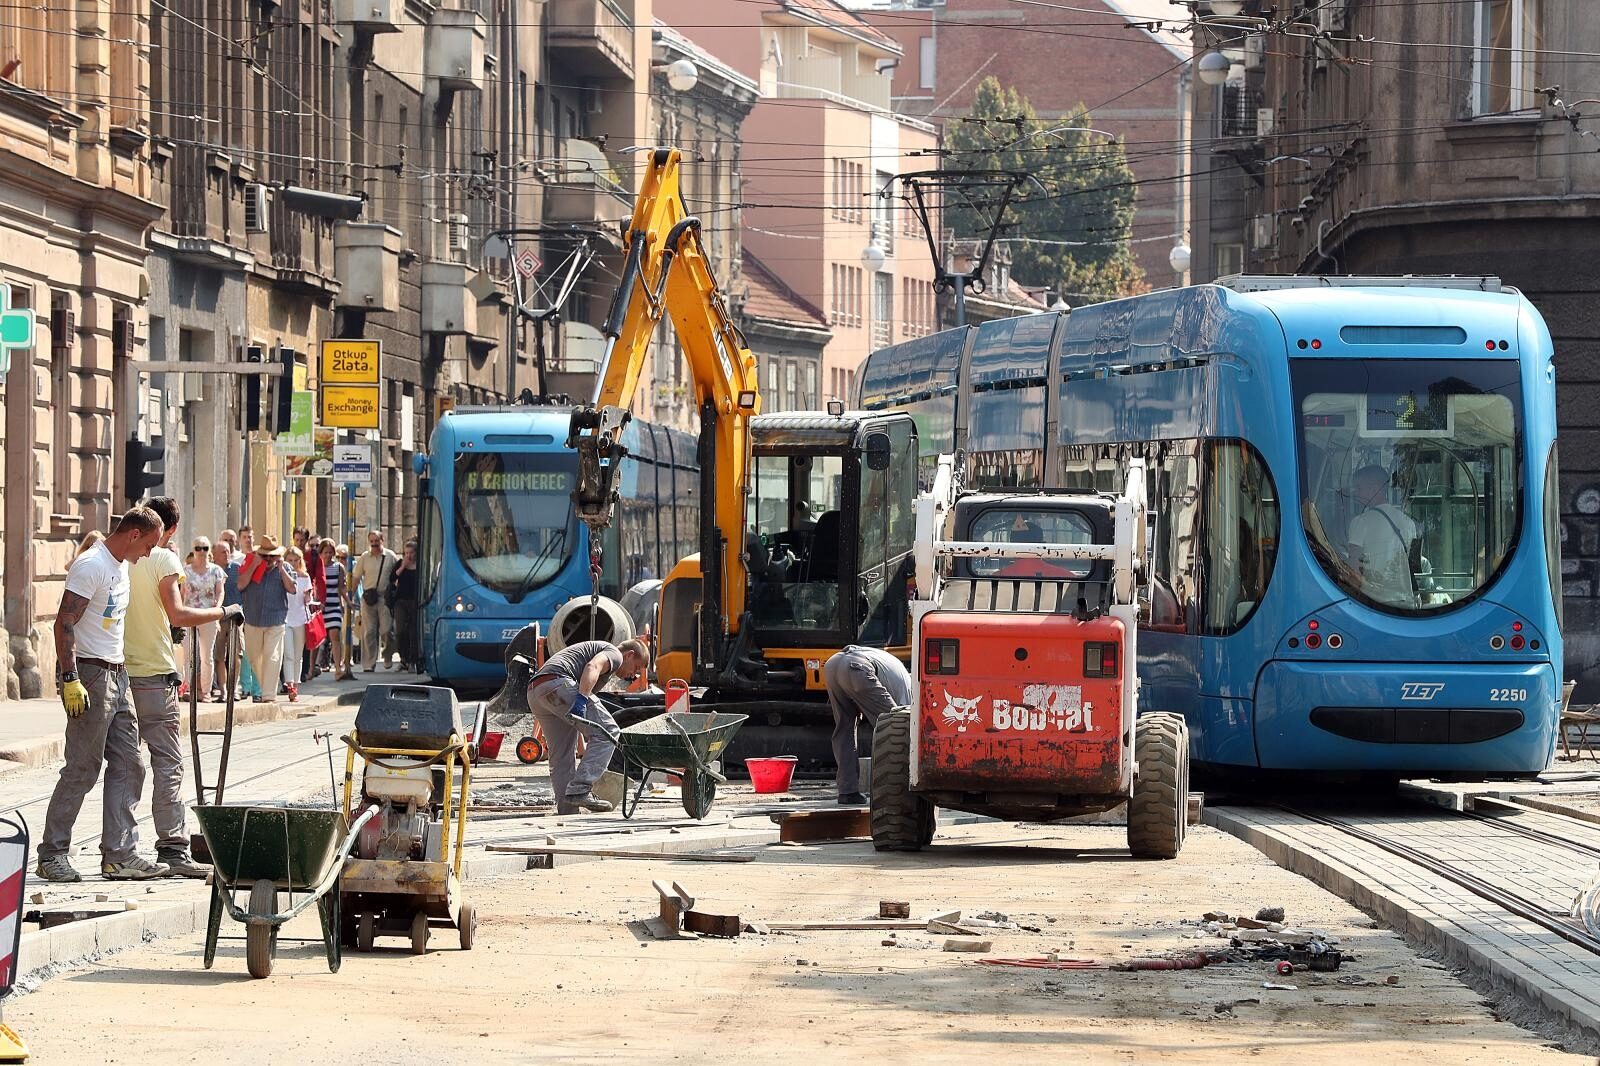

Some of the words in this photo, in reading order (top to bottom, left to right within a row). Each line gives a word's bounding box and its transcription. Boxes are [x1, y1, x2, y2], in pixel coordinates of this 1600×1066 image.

[333, 349, 367, 360] Otkup
[1396, 396, 1414, 428] 2
[468, 472, 477, 490] 6
[455, 631, 477, 640] 2225
[1401, 682, 1446, 700] ZET
[1490, 688, 1527, 701] 2250
